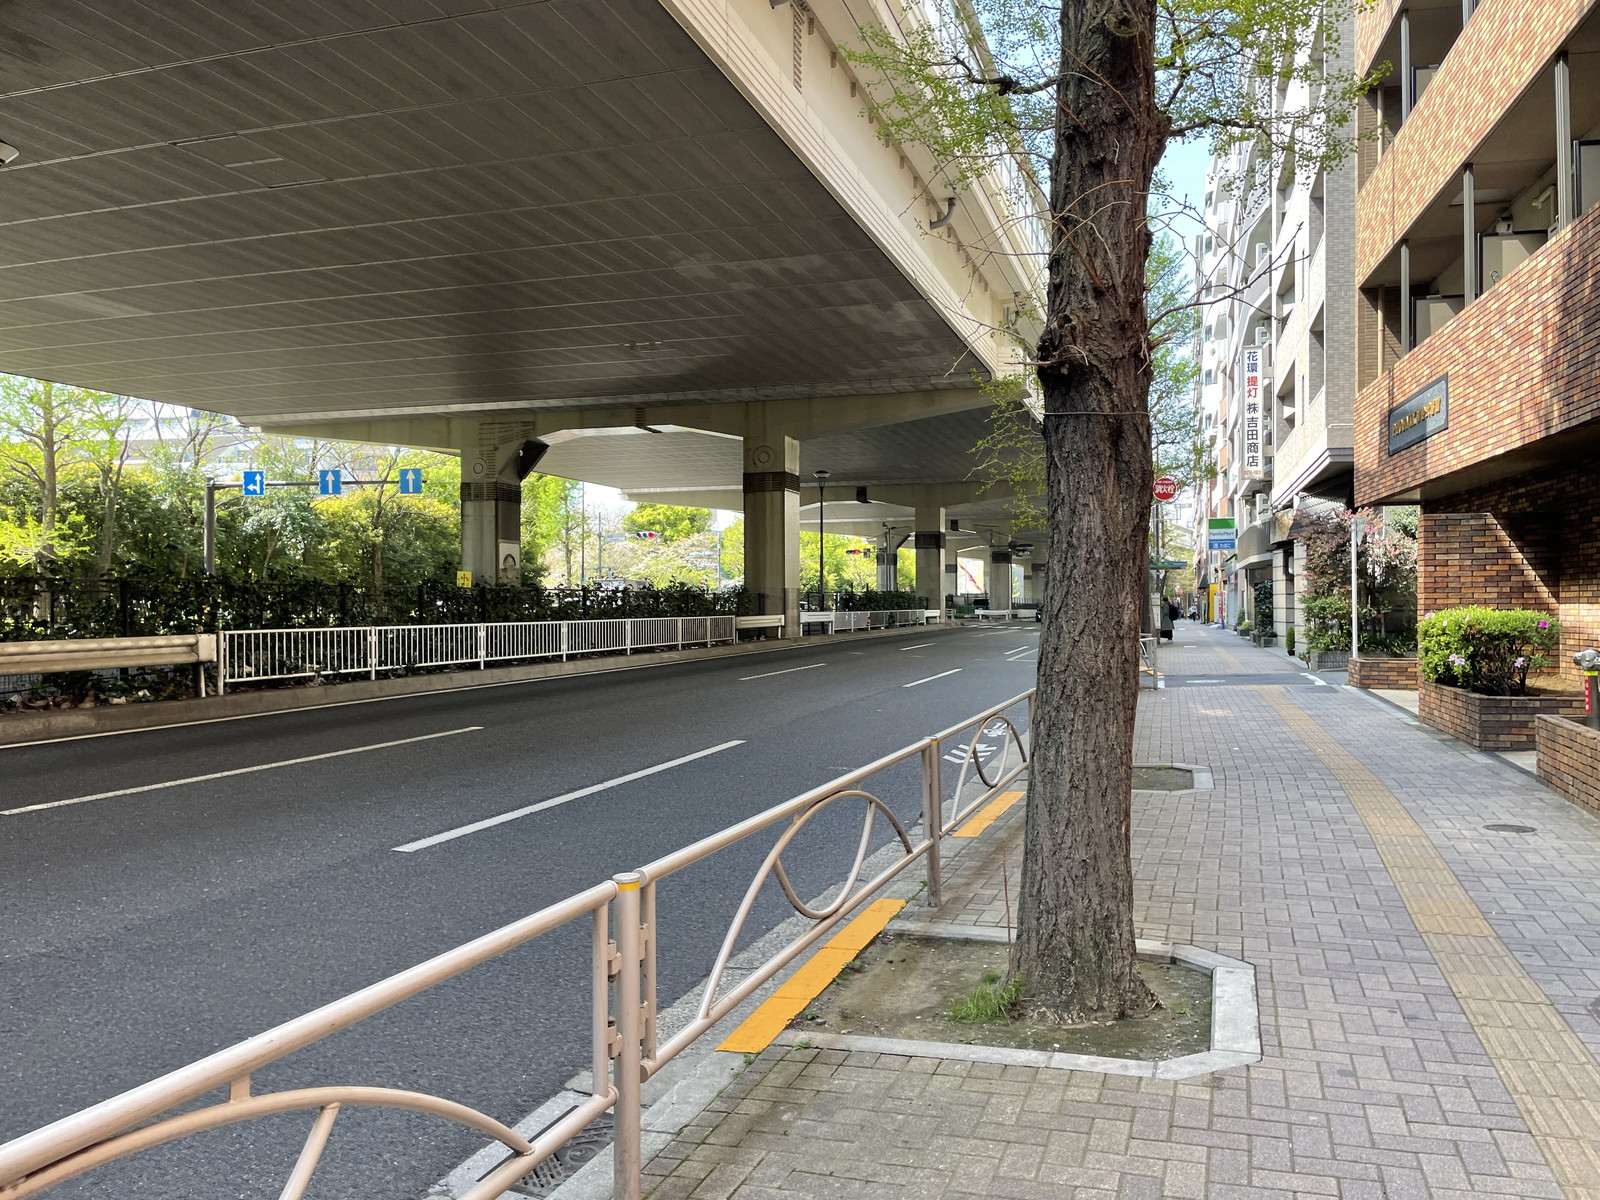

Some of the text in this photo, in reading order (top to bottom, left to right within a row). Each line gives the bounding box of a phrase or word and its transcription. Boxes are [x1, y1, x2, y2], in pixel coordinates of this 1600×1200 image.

[1247, 351, 1258, 373] 花環
[1247, 376, 1258, 398] 提灯
[1155, 484, 1175, 493] 消火栓
